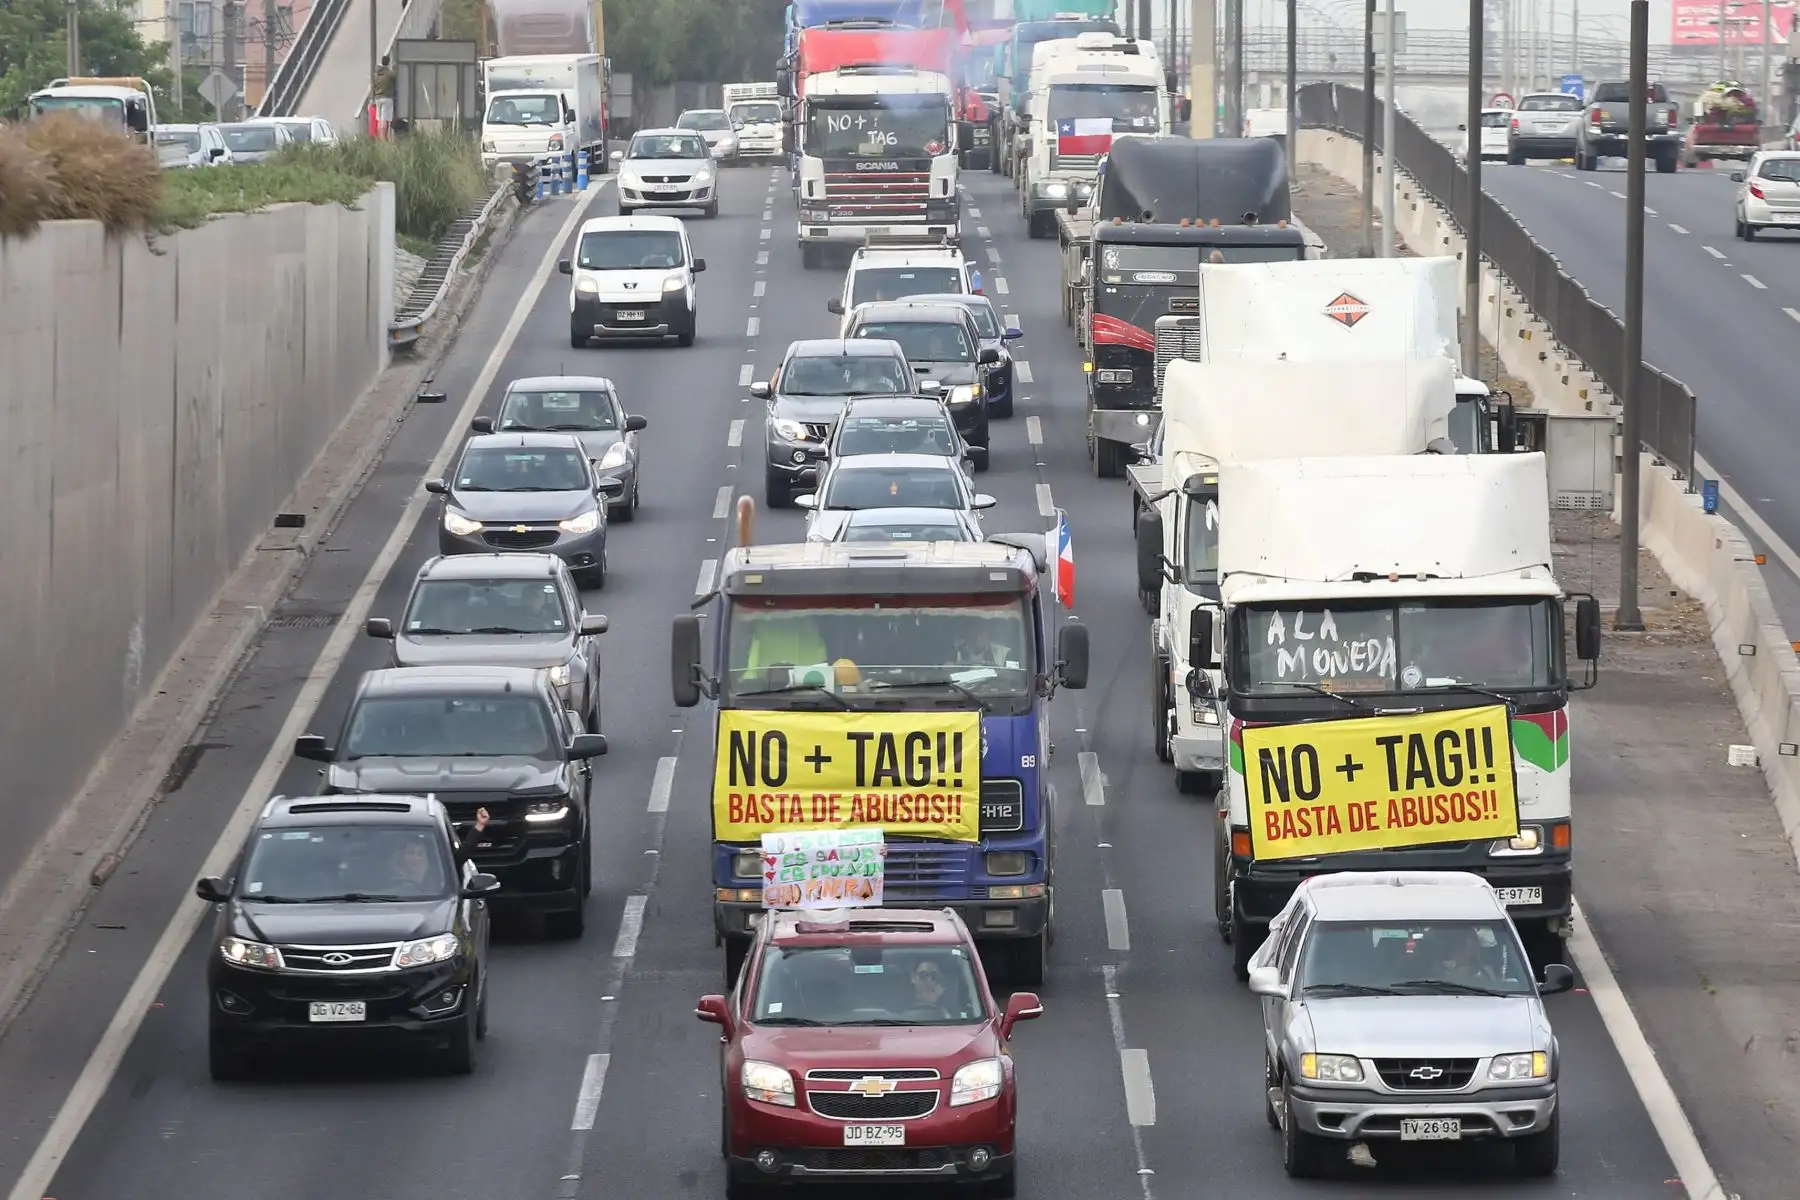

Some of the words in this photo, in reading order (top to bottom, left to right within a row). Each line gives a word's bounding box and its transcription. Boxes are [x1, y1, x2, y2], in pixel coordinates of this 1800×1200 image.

[828, 114, 851, 133] NO
[867, 131, 898, 146] TAG
[856, 162, 899, 171] SCANIA
[1267, 609, 1286, 645] A
[1277, 634, 1397, 681] MONEDA
[728, 730, 788, 787] NO
[804, 745, 832, 773] +
[847, 731, 962, 788] TAG!!
[1258, 743, 1321, 804] NO
[1335, 753, 1364, 782] +
[1376, 726, 1496, 792] TAG!!
[729, 793, 804, 823] BASTA
[812, 793, 842, 822] DE
[849, 793, 961, 824] ABUSOS!!
[1265, 805, 1341, 841] BASTA
[1347, 801, 1380, 832] DE
[1387, 790, 1498, 829] ABUSOS!!
